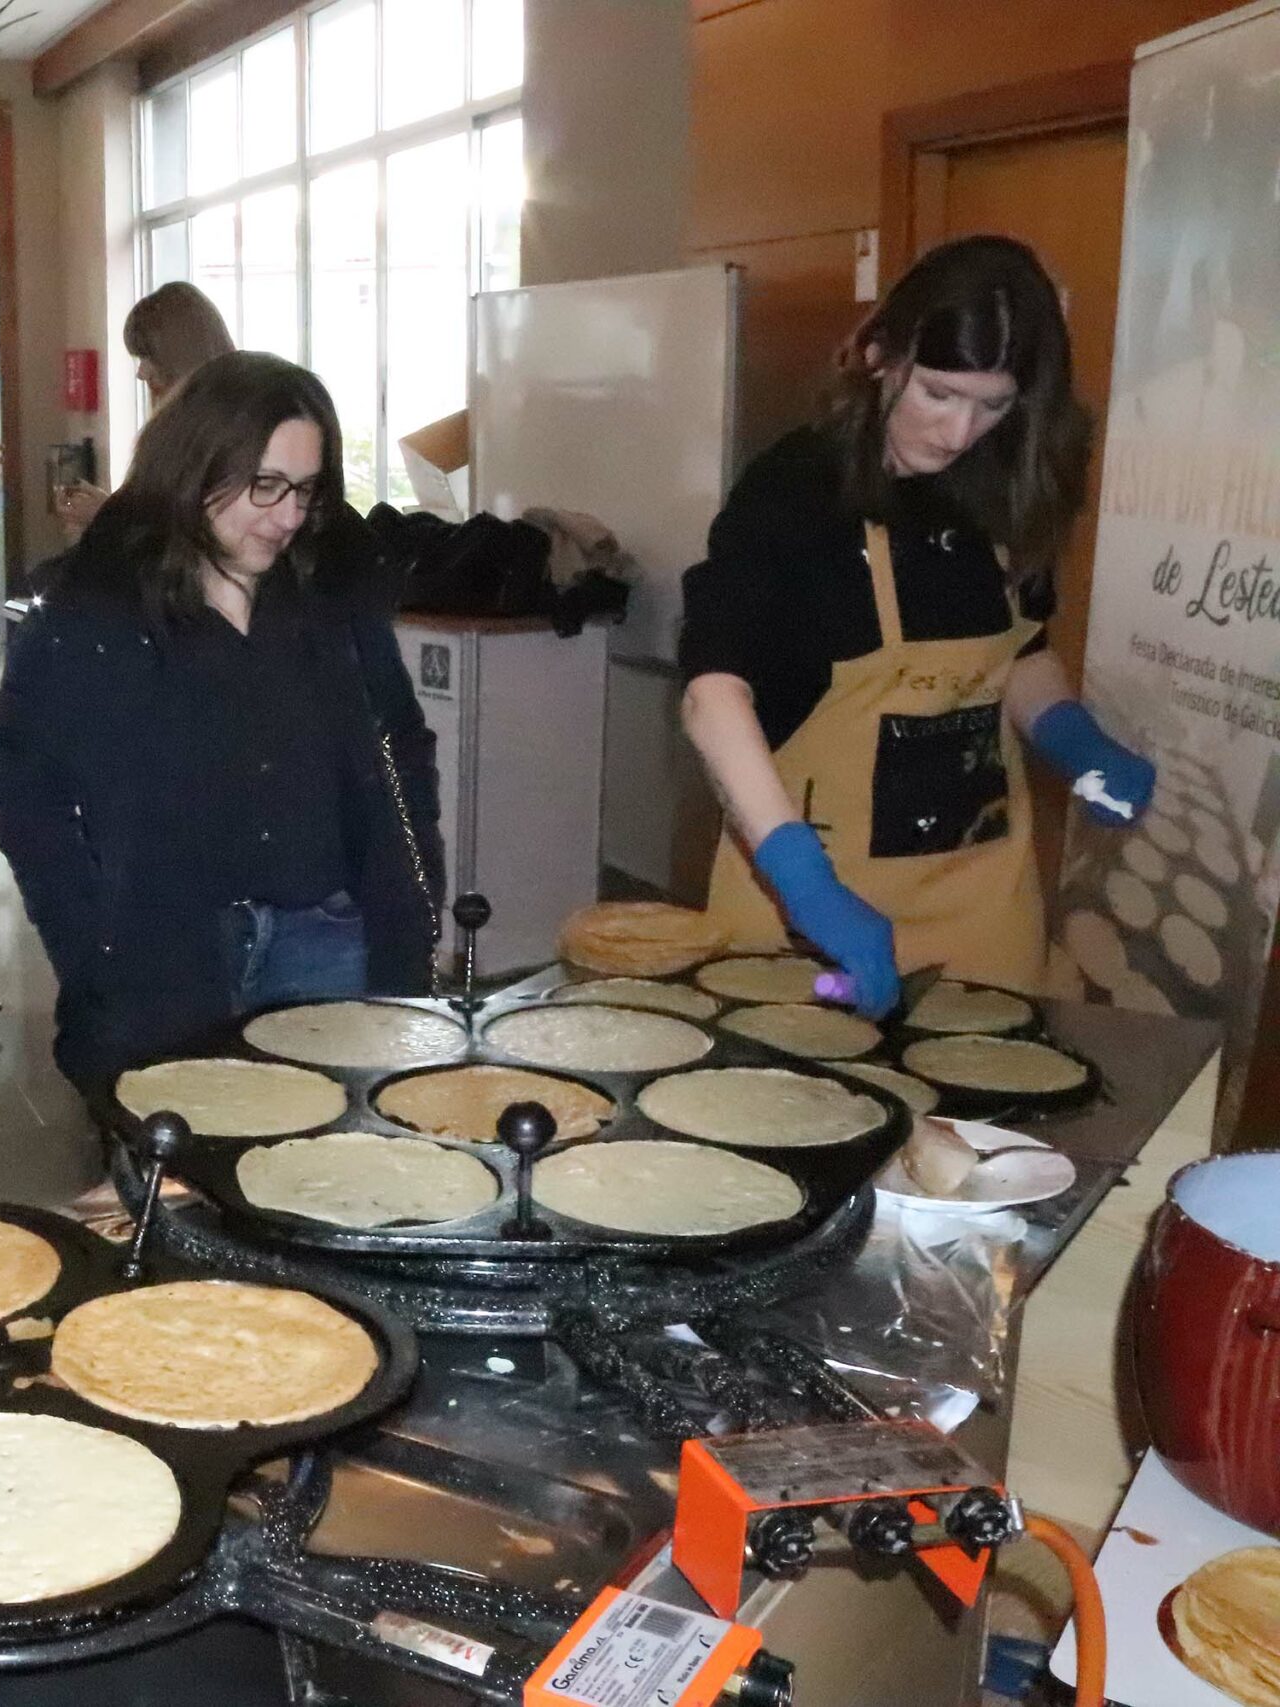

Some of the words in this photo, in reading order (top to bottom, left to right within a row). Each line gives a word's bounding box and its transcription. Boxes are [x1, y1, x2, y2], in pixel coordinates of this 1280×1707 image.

[1152, 544, 1182, 596] de
[1158, 641, 1217, 680] Declarada
[1220, 660, 1237, 686] de
[1223, 699, 1239, 724] de
